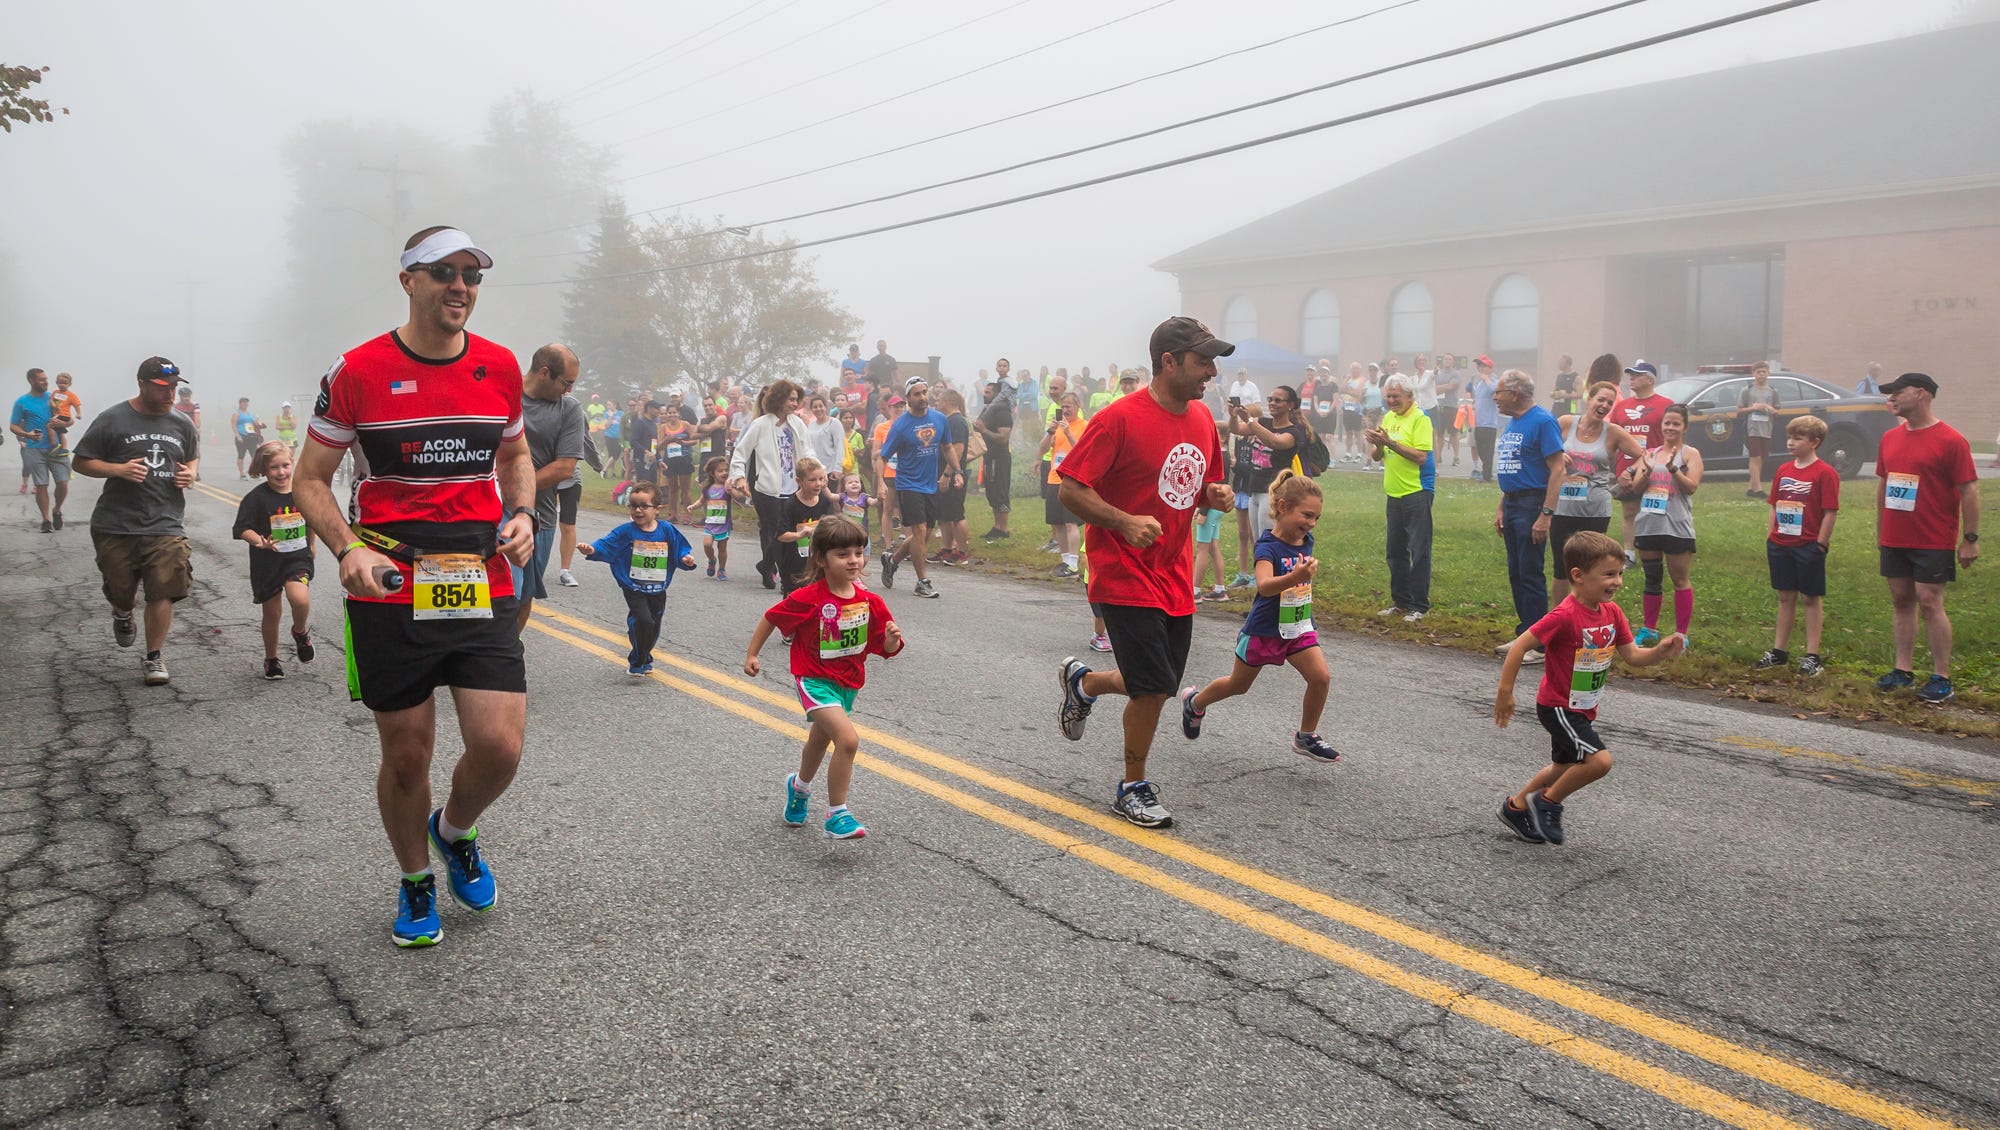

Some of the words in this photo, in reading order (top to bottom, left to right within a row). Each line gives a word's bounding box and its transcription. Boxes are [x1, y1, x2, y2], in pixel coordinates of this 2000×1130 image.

[1912, 296, 1977, 311] TOWN
[1625, 425, 1650, 433] RWB
[125, 434, 149, 444] LAKE
[401, 438, 466, 453] BEACON
[402, 449, 492, 463] ENDURANCE
[1888, 486, 1908, 499] 397
[284, 527, 299, 540] 23
[643, 556, 657, 569] 83
[431, 583, 478, 608] 854
[840, 627, 859, 648] 53
